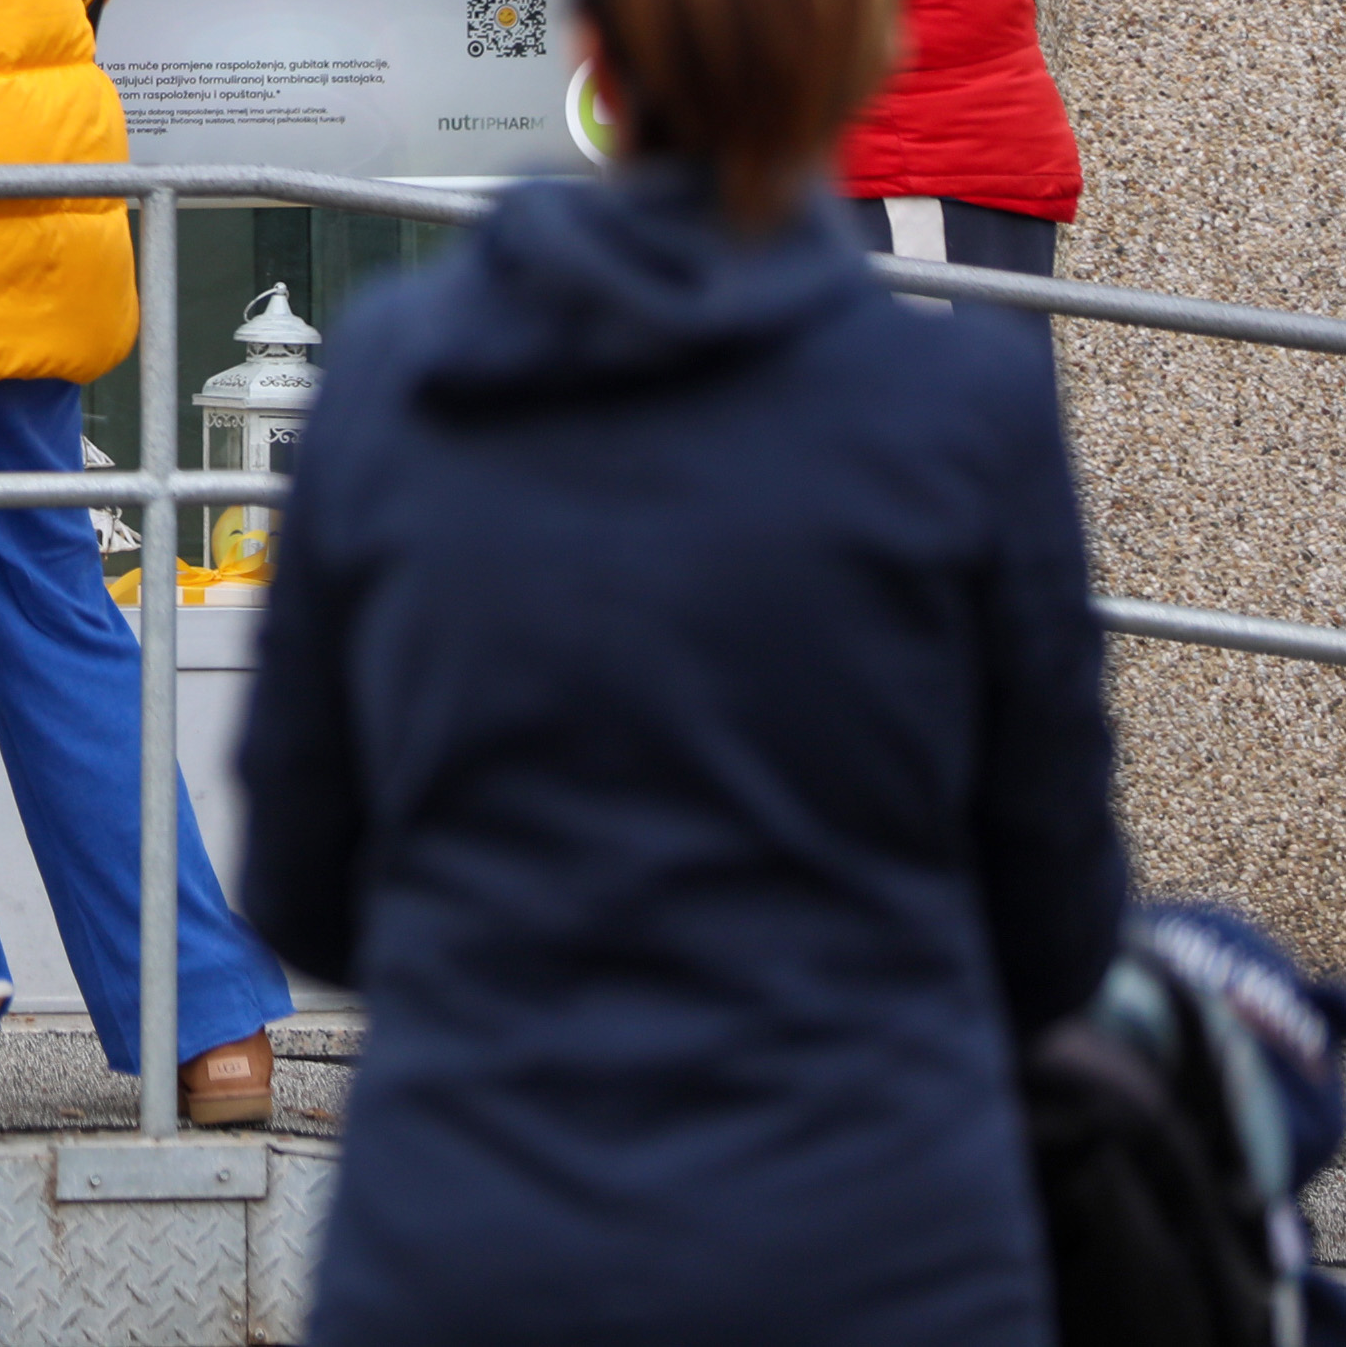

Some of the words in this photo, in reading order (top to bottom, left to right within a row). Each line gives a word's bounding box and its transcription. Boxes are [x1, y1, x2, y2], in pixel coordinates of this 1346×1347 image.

[128, 61, 158, 70] muče
[162, 61, 212, 73] promjene
[216, 60, 286, 72] raspoloženja,
[289, 59, 329, 71] gubitak
[332, 59, 390, 70] motivacije,
[156, 75, 196, 86] pažljivo
[199, 75, 264, 86] formuliranoj
[267, 74, 328, 85] kombinaciji
[331, 74, 385, 85] sastojaka,
[143, 90, 210, 101] raspoloženju
